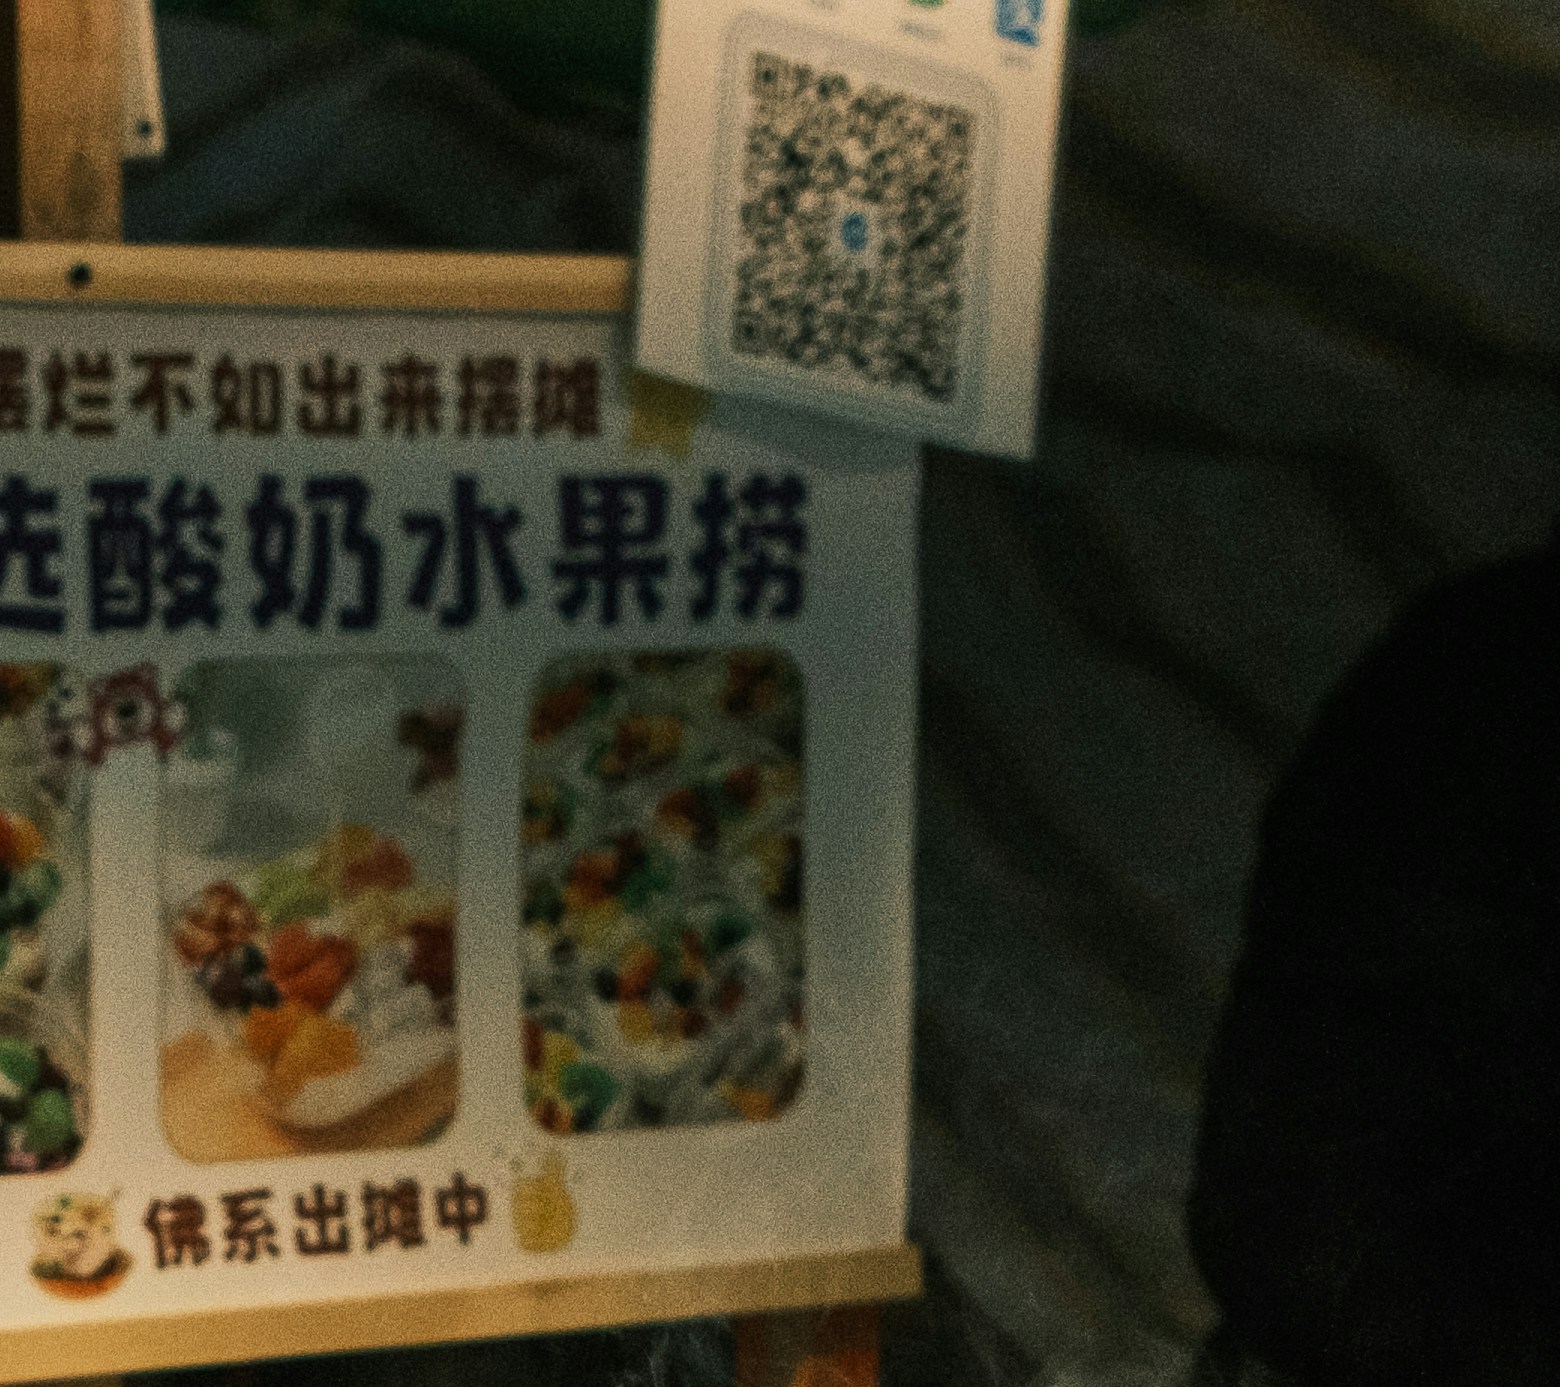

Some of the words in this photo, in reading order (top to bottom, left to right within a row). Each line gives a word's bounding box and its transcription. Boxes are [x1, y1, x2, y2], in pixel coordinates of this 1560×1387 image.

[144, 1170, 489, 1269] 佛系出摊中
